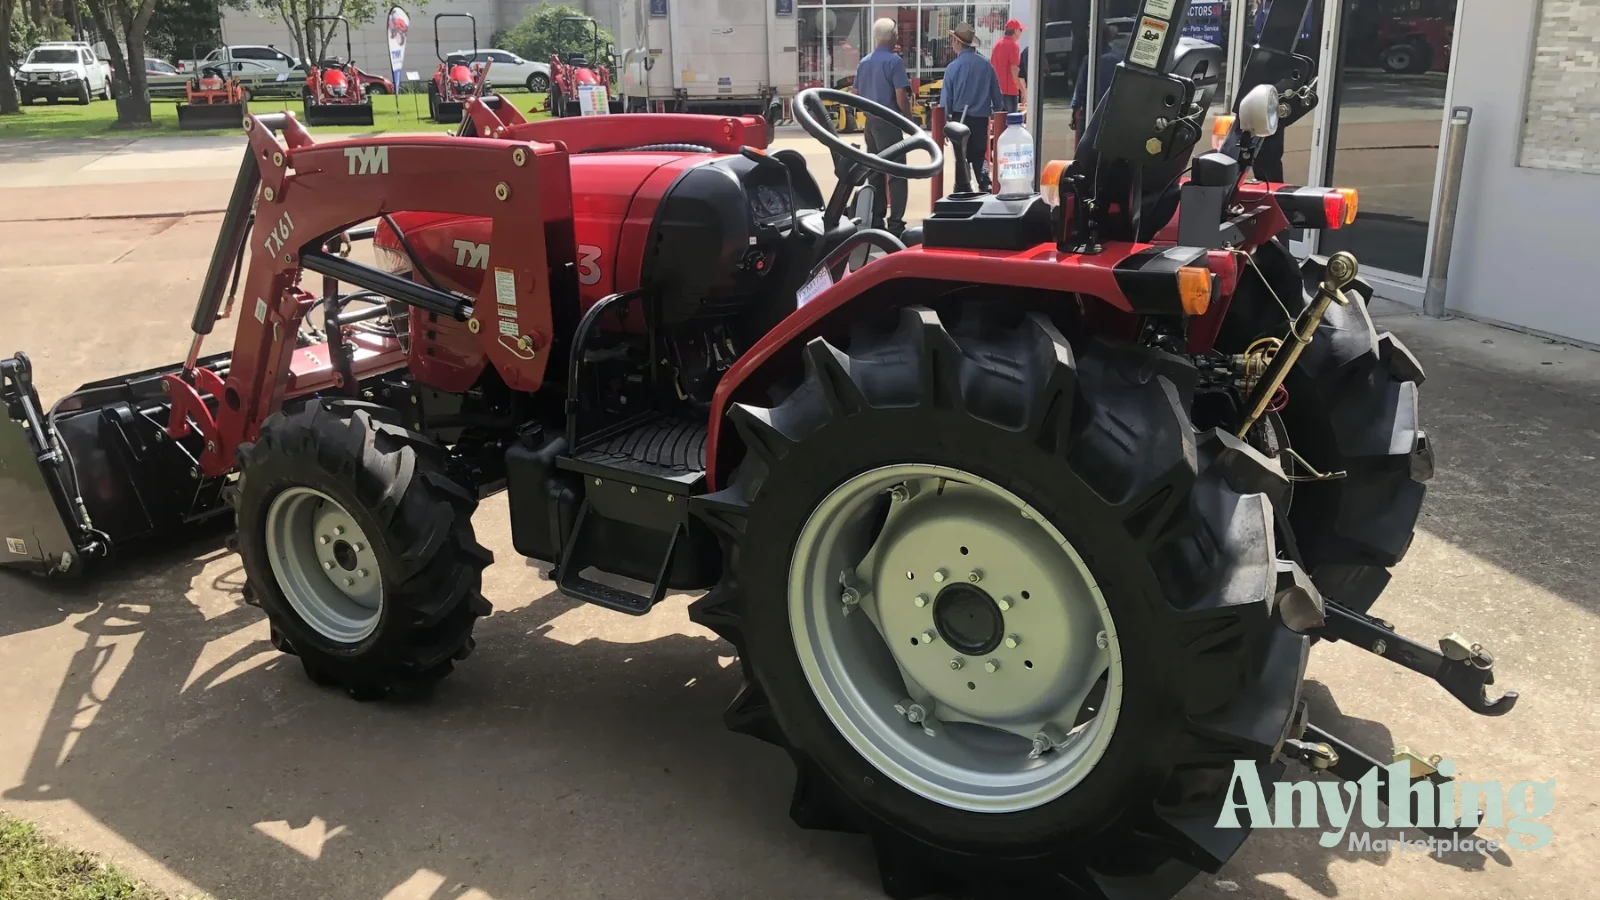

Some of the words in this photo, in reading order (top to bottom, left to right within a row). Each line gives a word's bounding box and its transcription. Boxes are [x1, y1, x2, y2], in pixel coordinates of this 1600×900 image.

[1203, 24, 1219, 32] Service
[343, 145, 389, 176] TYM
[1003, 161, 1030, 170] SPRING
[263, 210, 296, 260] TX61
